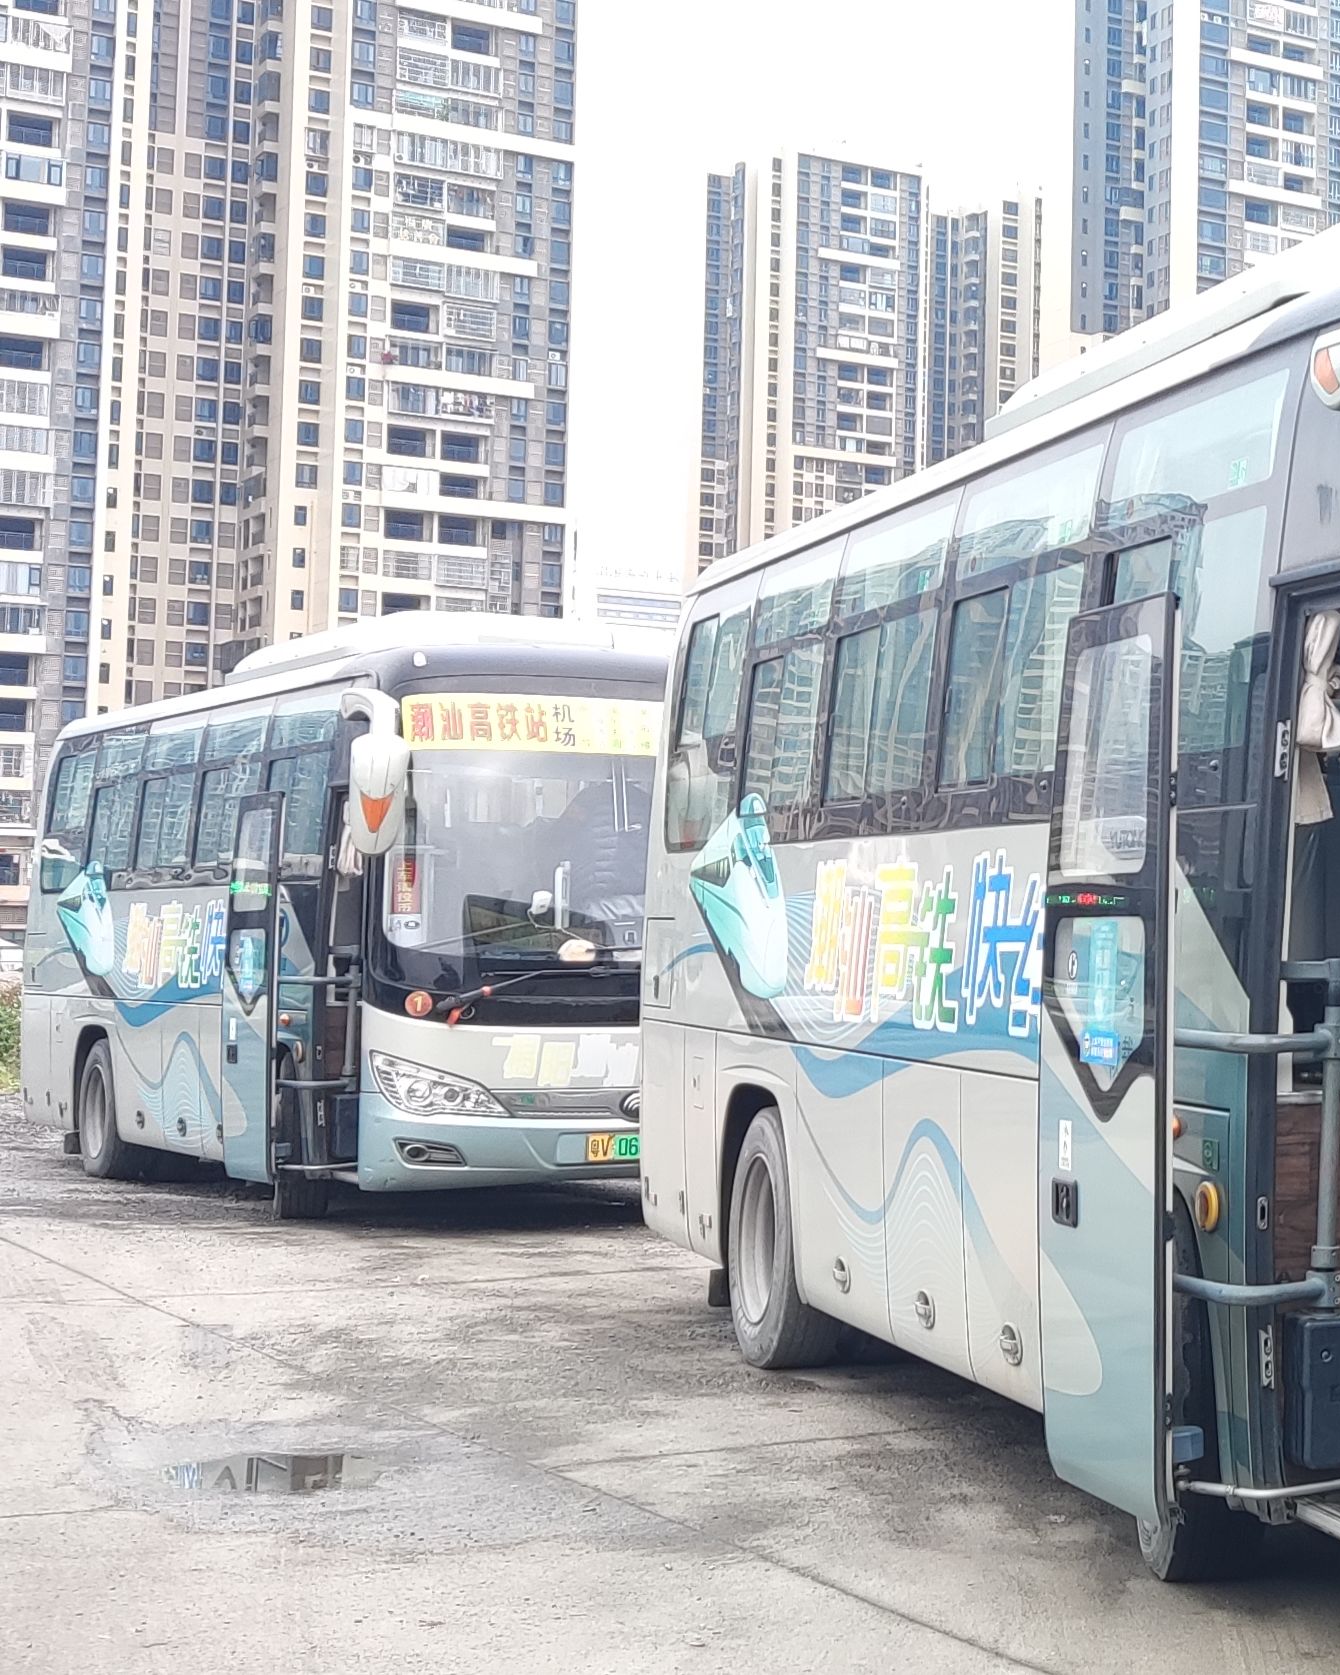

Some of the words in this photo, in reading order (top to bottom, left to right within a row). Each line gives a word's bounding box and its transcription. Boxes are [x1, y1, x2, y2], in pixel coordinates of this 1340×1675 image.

[409, 702, 549, 743] 潮汕高铁站
[552, 703, 577, 748] 机场
[414, 996, 423, 1012] 1
